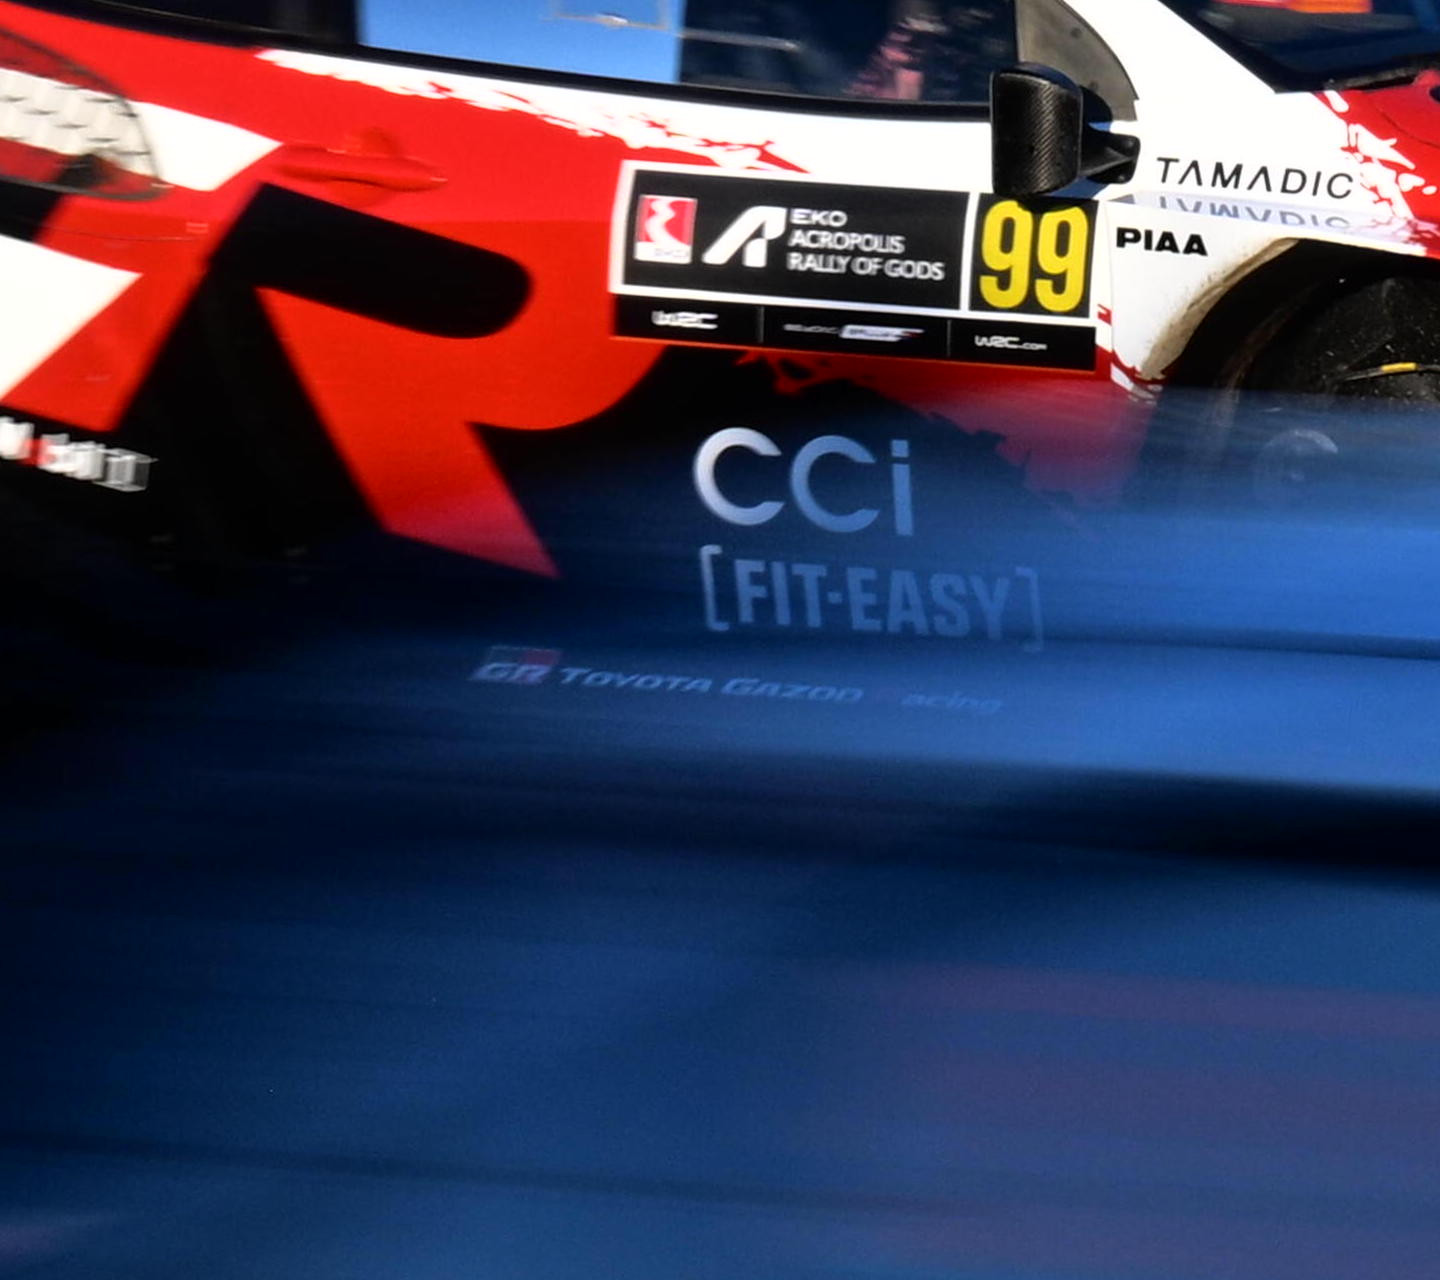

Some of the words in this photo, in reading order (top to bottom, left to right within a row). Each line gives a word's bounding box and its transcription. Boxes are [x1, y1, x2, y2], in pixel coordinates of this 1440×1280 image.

[1156, 156, 1354, 200] TAMADIC
[789, 207, 848, 228] EKO
[787, 229, 906, 255] ACROPOLIS
[978, 199, 1089, 314] 99
[1115, 226, 1209, 257] PIAA
[786, 251, 849, 275] RALLY
[851, 255, 883, 276] OF
[883, 258, 946, 282] GODS
[692, 426, 915, 537] CCi
[559, 667, 712, 694] TOYOTA
